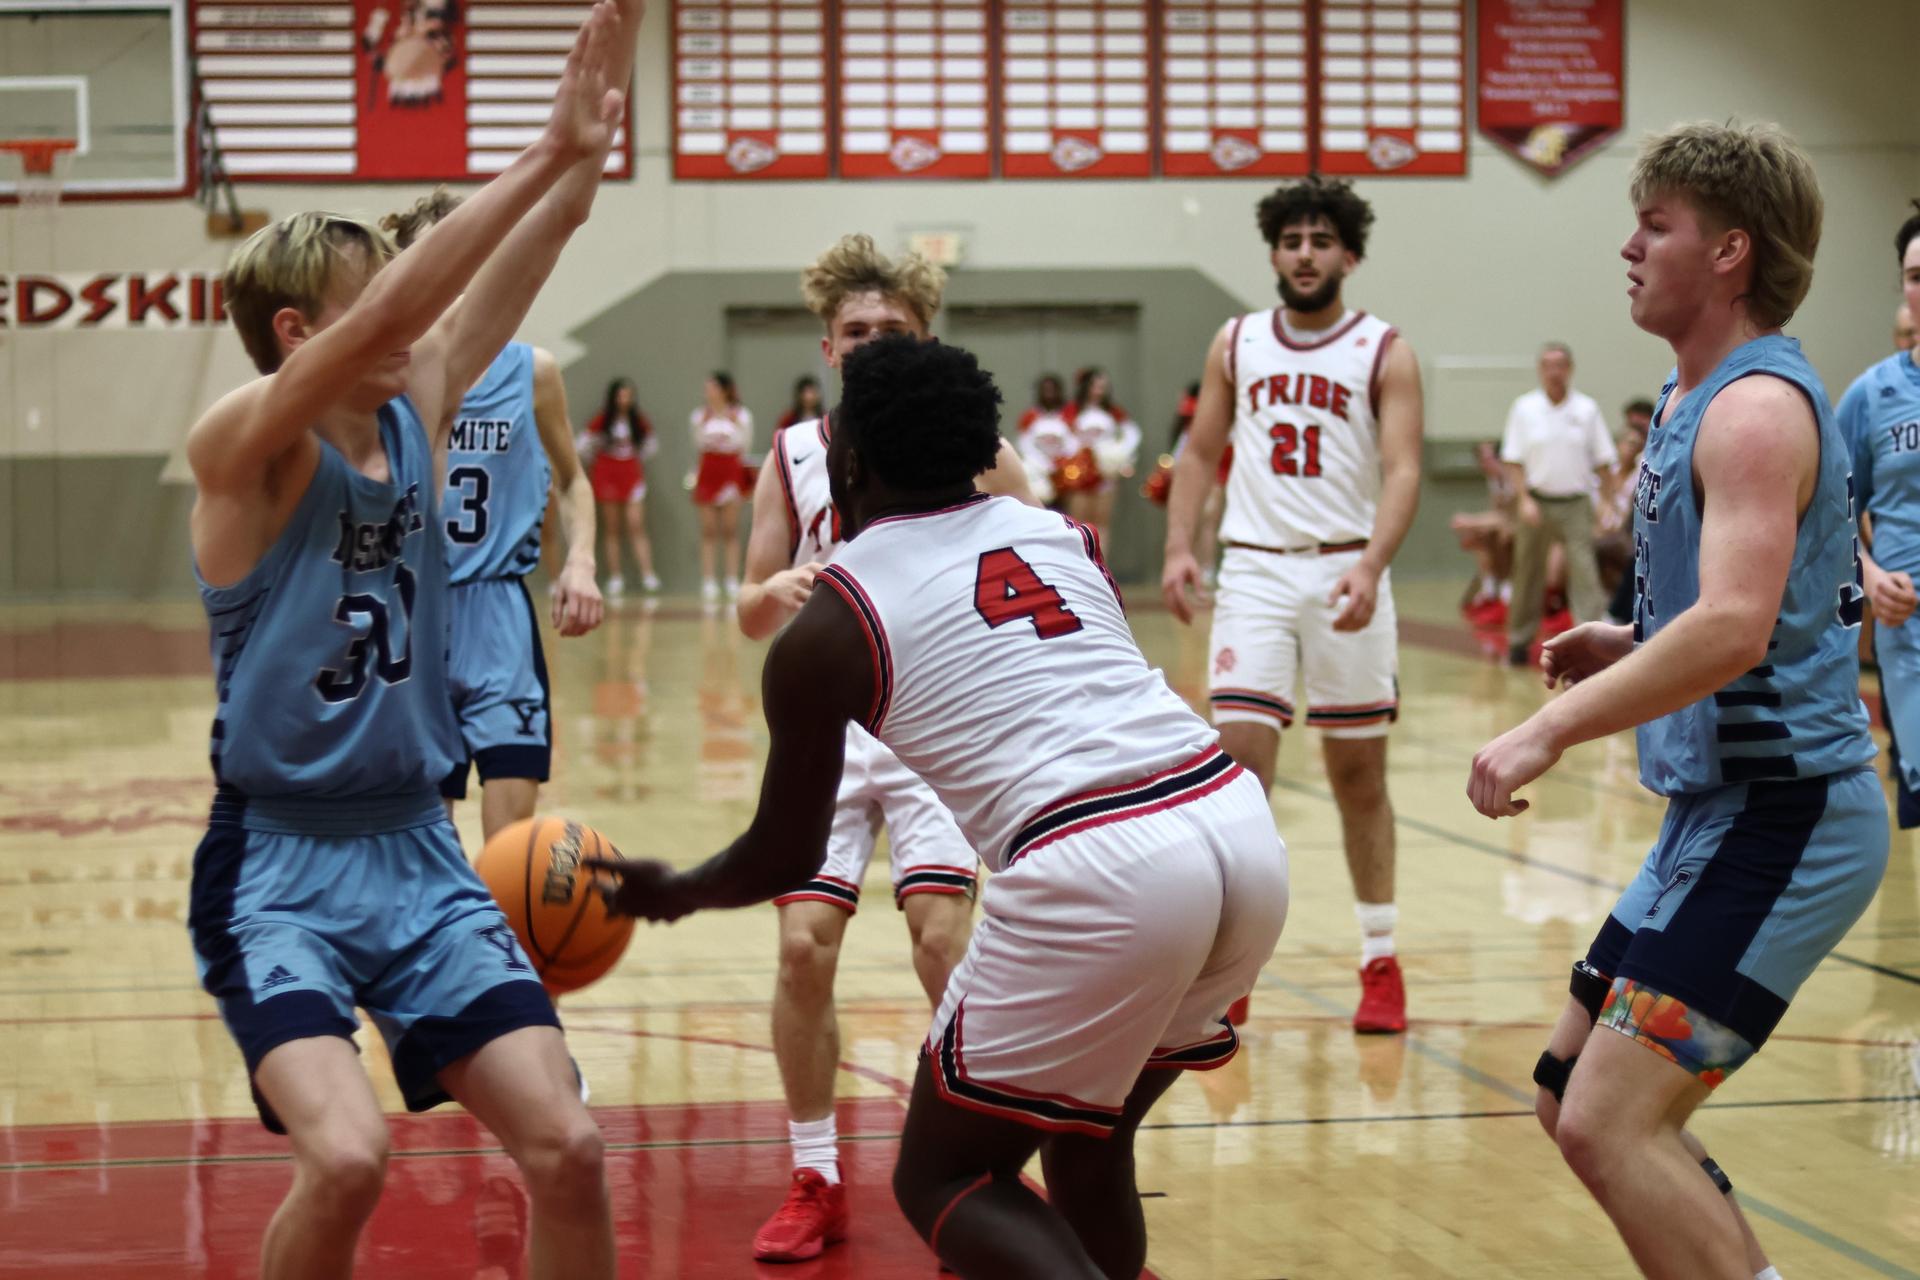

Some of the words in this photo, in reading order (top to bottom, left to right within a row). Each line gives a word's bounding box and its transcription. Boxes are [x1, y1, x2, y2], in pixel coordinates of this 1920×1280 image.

[1248, 373, 1352, 421] TRIBE
[1269, 422, 1322, 477] 21
[445, 465, 490, 544] 3
[974, 546, 1084, 640] 4
[313, 562, 418, 705] 30
[475, 925, 531, 973] Y
